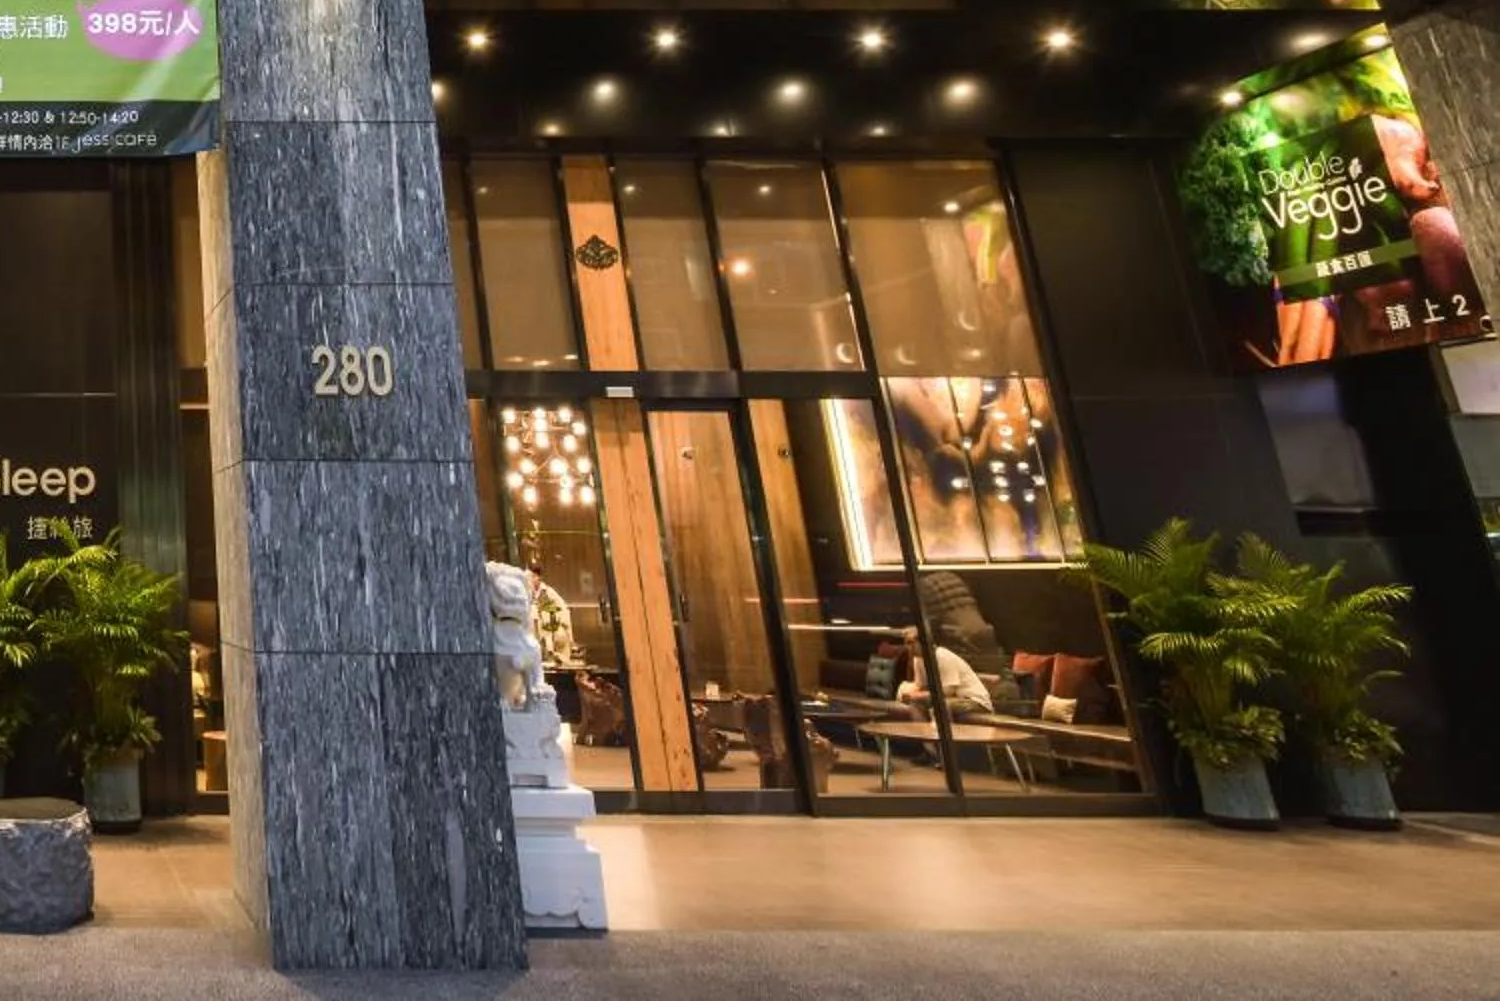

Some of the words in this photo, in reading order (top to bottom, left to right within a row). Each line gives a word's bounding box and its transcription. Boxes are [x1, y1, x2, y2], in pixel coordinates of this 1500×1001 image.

[88, 10, 200, 35] 398元/人
[1258, 149, 1346, 197] Double
[1261, 157, 1387, 240] Veggie
[311, 345, 394, 396] 280
